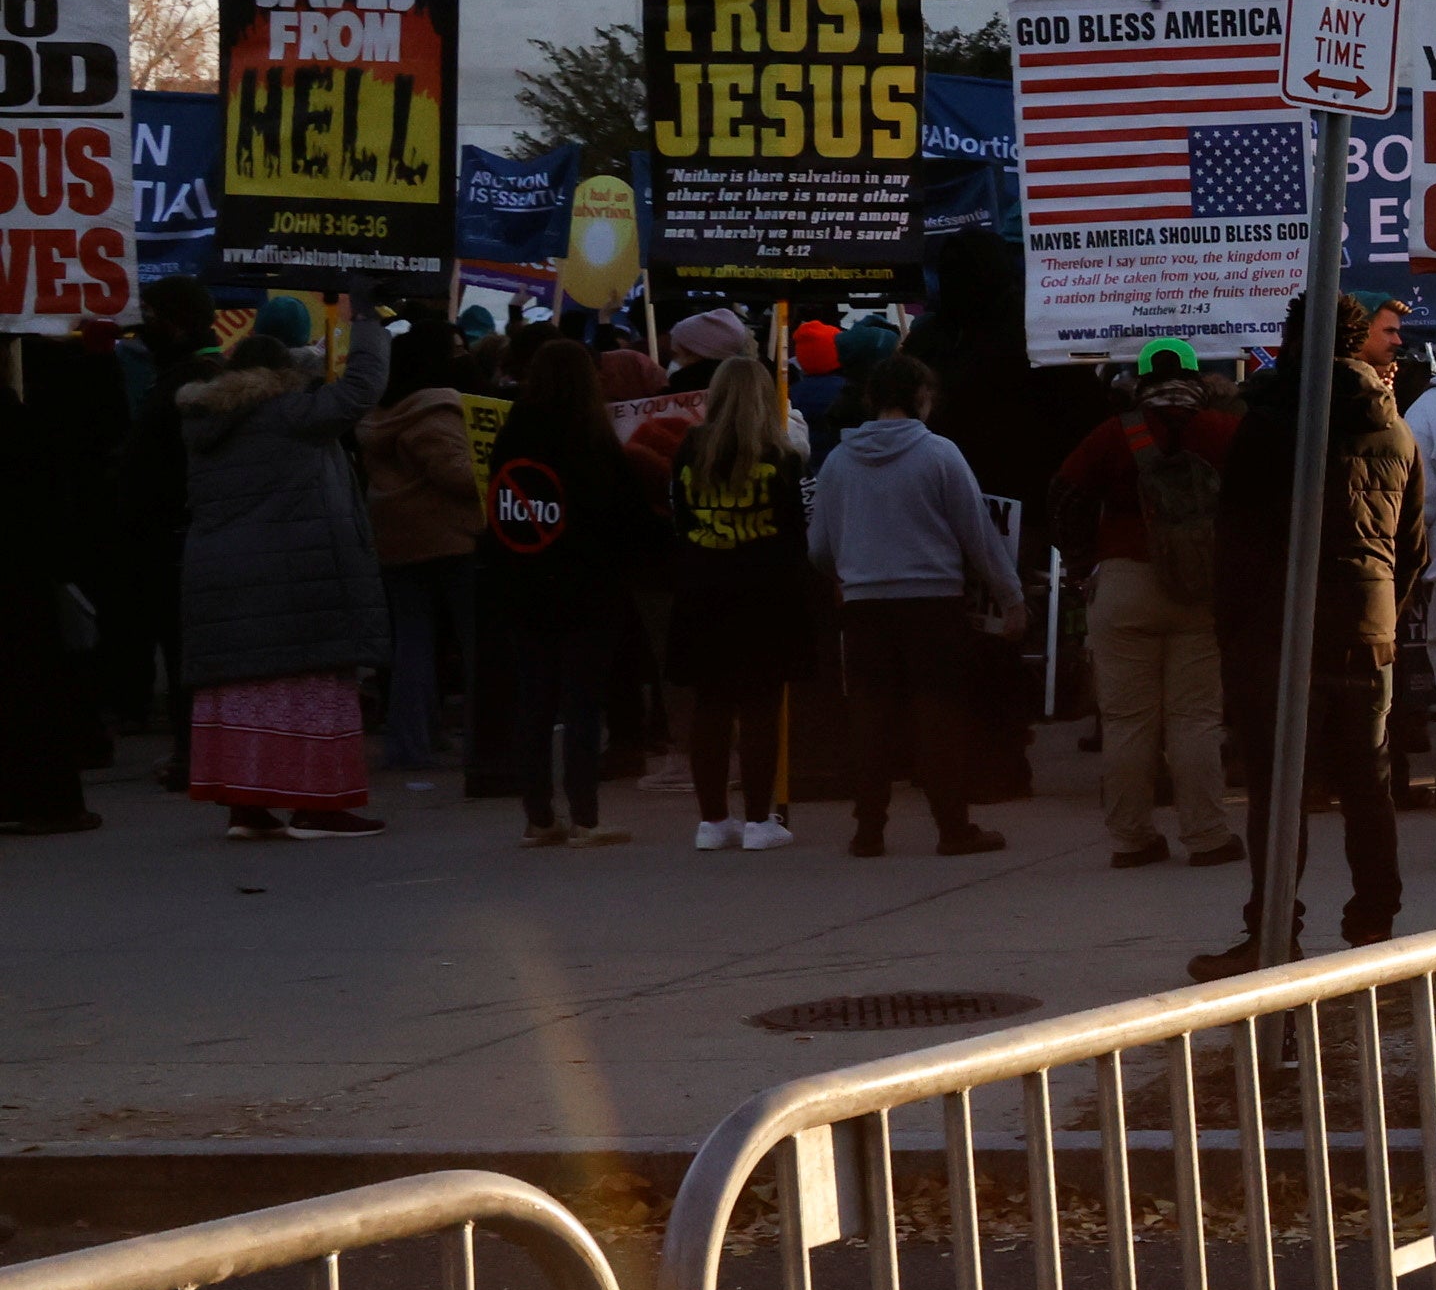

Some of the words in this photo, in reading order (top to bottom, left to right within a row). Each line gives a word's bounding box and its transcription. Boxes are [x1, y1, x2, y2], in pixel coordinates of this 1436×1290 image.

[1017, 16, 1069, 46] GOD
[1079, 12, 1155, 42] BLESS
[1164, 8, 1282, 40] AMERICA
[1319, 7, 1365, 38] ANY
[269, 10, 401, 62] FROM
[1315, 37, 1366, 69] TIME
[655, 63, 919, 159] JESUS
[236, 67, 429, 186] HELL
[789, 170, 860, 184] salvation
[883, 174, 909, 189] any
[747, 188, 788, 201] there
[816, 191, 858, 202] none
[863, 190, 909, 203] other
[269, 212, 322, 236] JOHN
[324, 213, 391, 239] 3:16-36
[755, 207, 806, 220] heaven
[811, 208, 855, 225] given
[859, 211, 909, 225] among
[703, 227, 764, 242] whereby
[793, 227, 829, 240] must
[1031, 231, 1081, 251] MAYBE
[1086, 228, 1155, 248] AMERICA
[1160, 225, 1220, 245] SHOULD
[1225, 223, 1271, 243] BLESS
[1276, 222, 1308, 241] GOD
[1140, 254, 1166, 266] unto
[1171, 253, 1198, 266] you,
[1227, 249, 1282, 265] kingdom
[1041, 275, 1067, 288] God
[1072, 274, 1100, 287] shall
[1123, 272, 1156, 285] taken
[1160, 270, 1188, 282] from
[1192, 271, 1220, 283] you,
[1224, 268, 1247, 280] and
[1252, 268, 1284, 281] given
[1055, 292, 1095, 304] nation
[1100, 290, 1151, 306] bringing
[1155, 289, 1184, 301] forth
[1213, 286, 1244, 298] fruits
[1132, 305, 1177, 316] Matthew
[1180, 303, 1211, 315] 21:43
[630, 399, 672, 416] YOU
